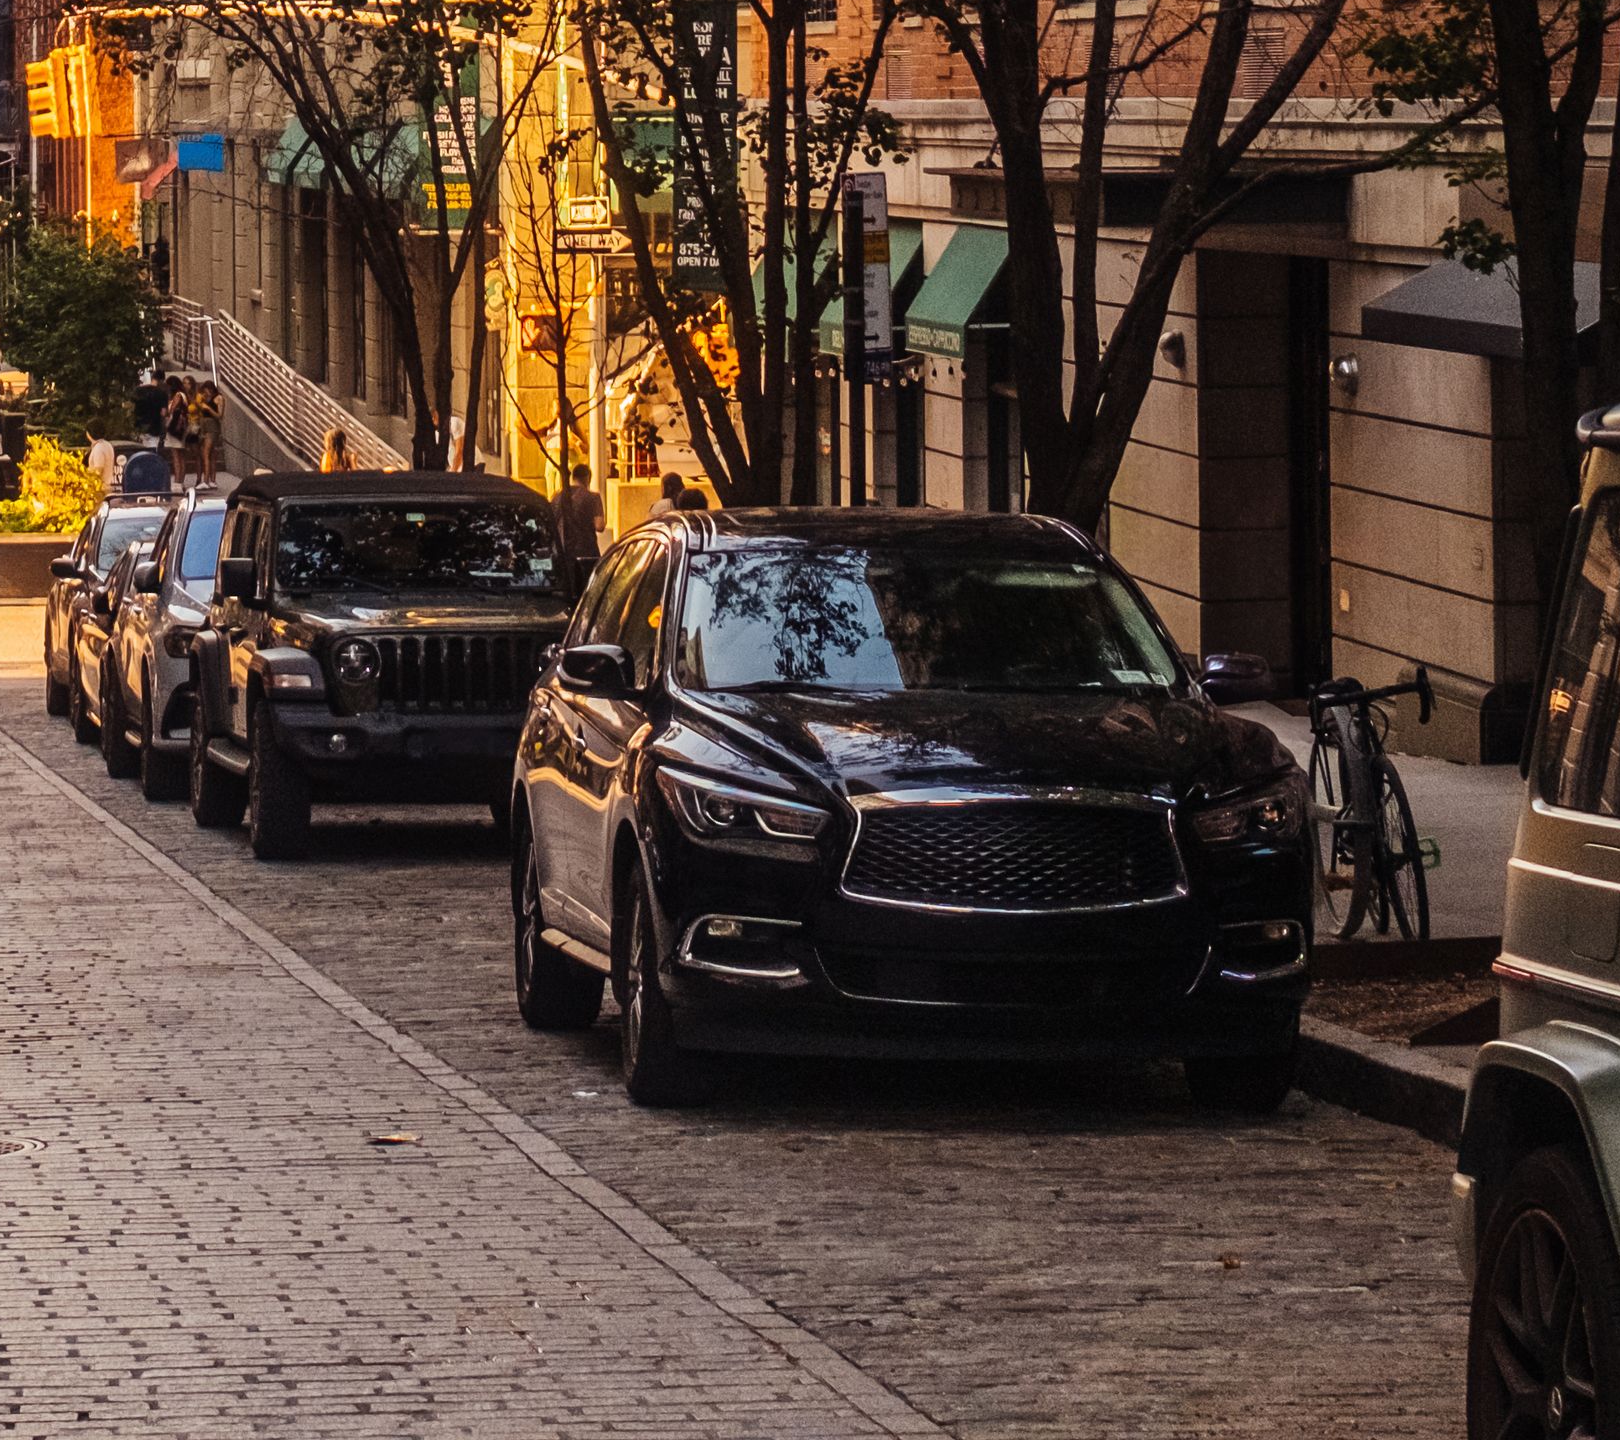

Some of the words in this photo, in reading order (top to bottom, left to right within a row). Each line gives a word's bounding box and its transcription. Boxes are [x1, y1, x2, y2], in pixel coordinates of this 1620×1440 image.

[564, 236, 587, 247] ONE
[598, 236, 622, 247] WAY
[677, 256, 701, 267] OPEN
[702, 256, 708, 267] 7
